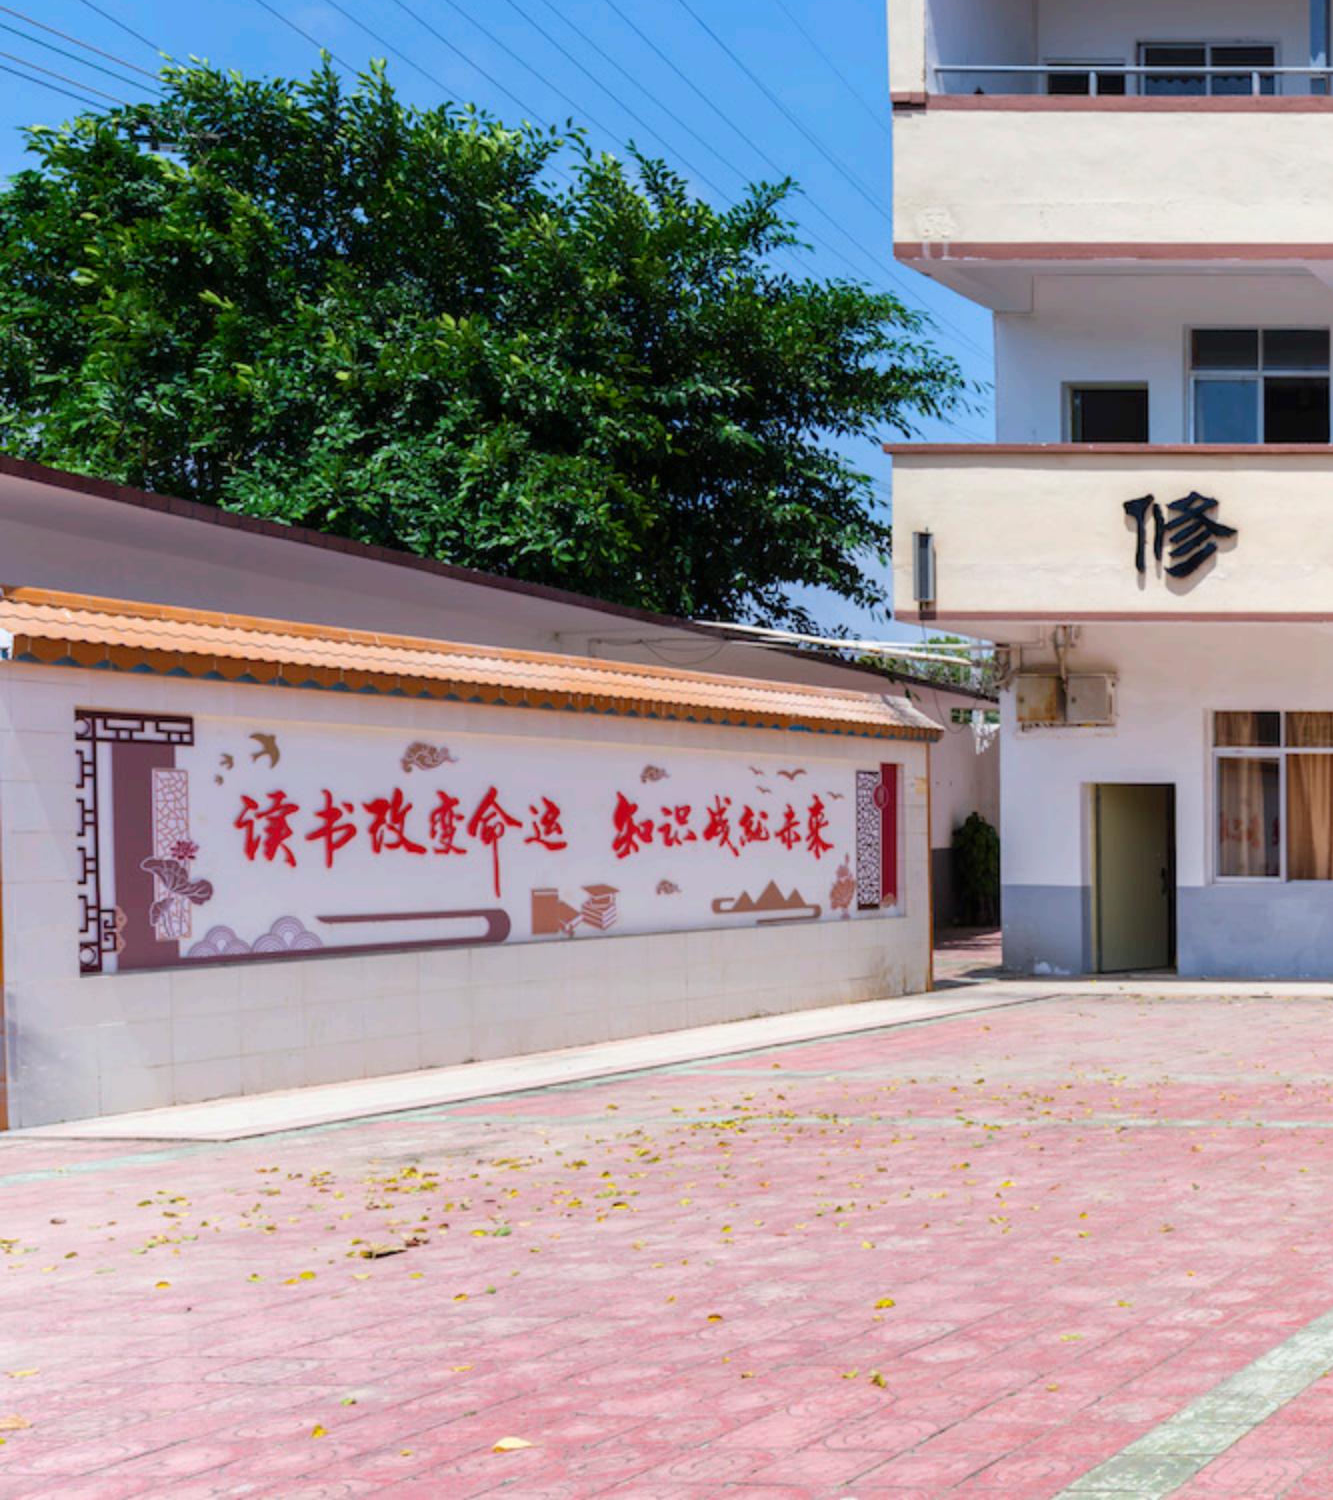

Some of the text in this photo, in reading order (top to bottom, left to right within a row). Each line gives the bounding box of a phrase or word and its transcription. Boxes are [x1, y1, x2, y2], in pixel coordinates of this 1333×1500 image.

[233, 786, 834, 899] 读书改变命运 知识成就未来
